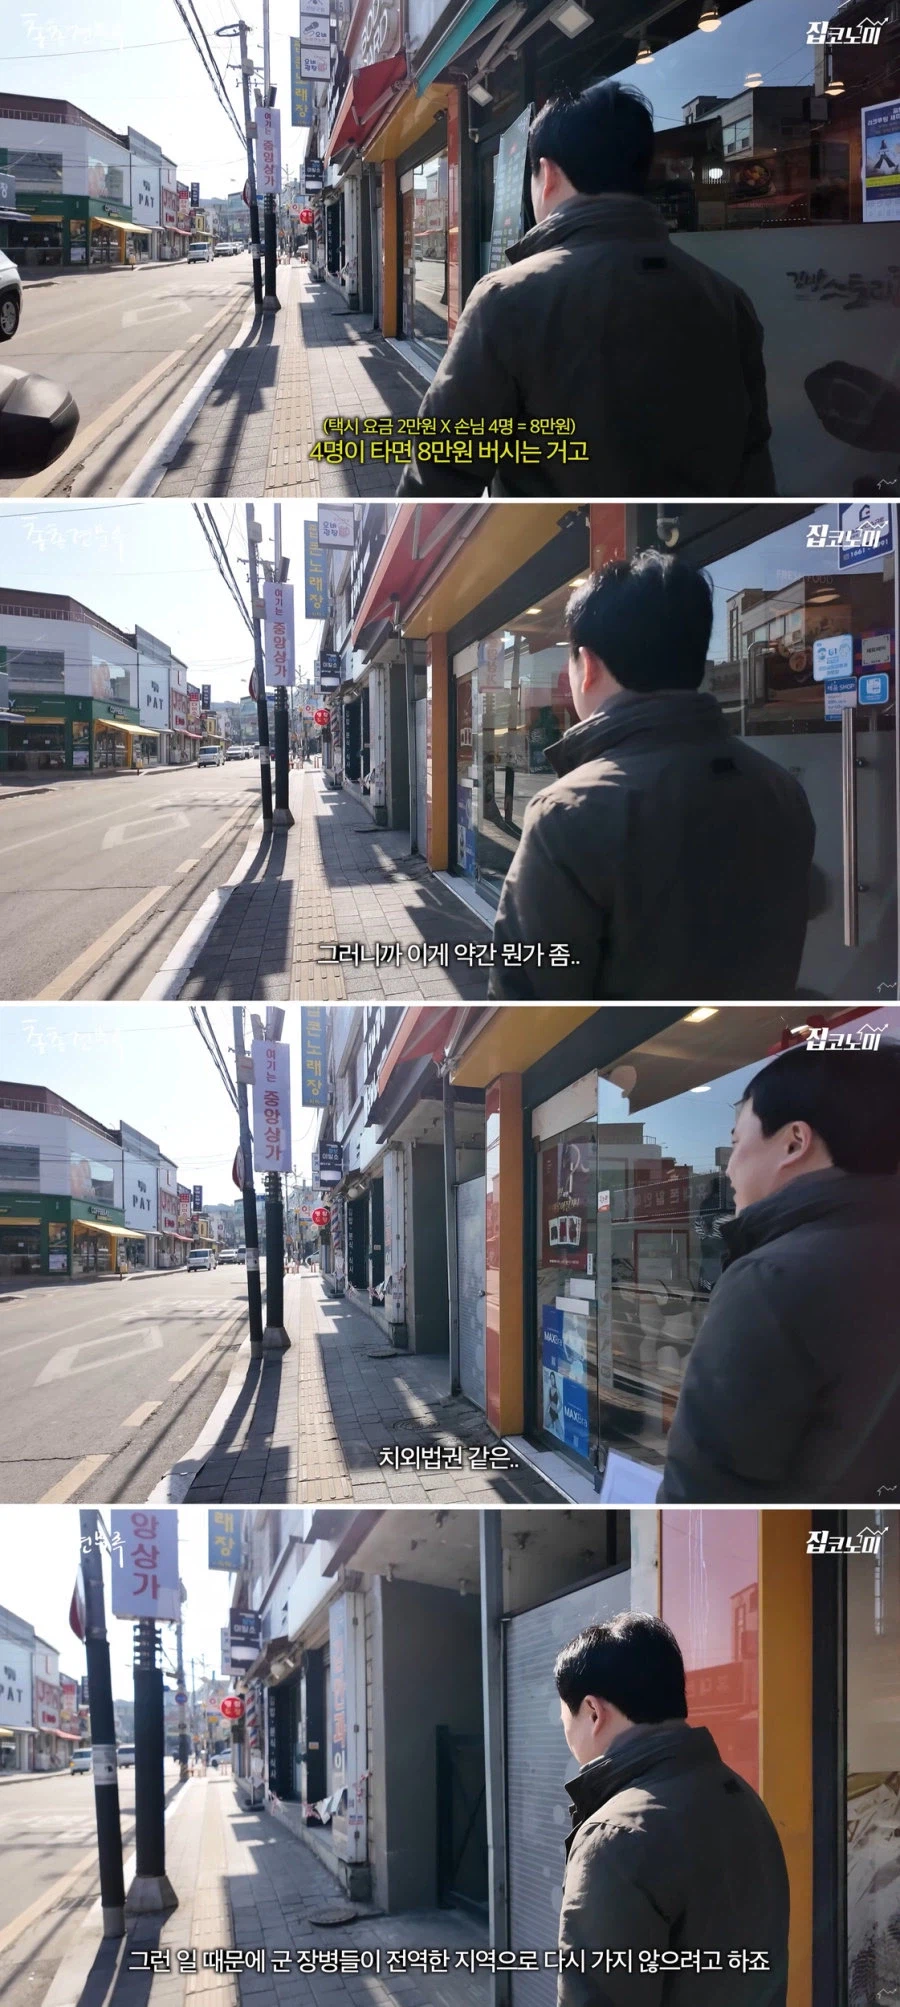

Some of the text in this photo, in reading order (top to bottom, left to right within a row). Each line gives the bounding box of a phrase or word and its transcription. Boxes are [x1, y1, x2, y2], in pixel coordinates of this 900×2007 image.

[263, 112, 275, 187] 여기는 중앙상가
[138, 193, 155, 208] PAT
[273, 588, 289, 678] 여기는 중앙상가
[147, 693, 164, 711] PAT
[263, 1048, 283, 1161] 여기는 중앙상가
[132, 1194, 151, 1211] PAT
[130, 1512, 161, 1601] 앙상가
[213, 1511, 236, 1557] 래장
